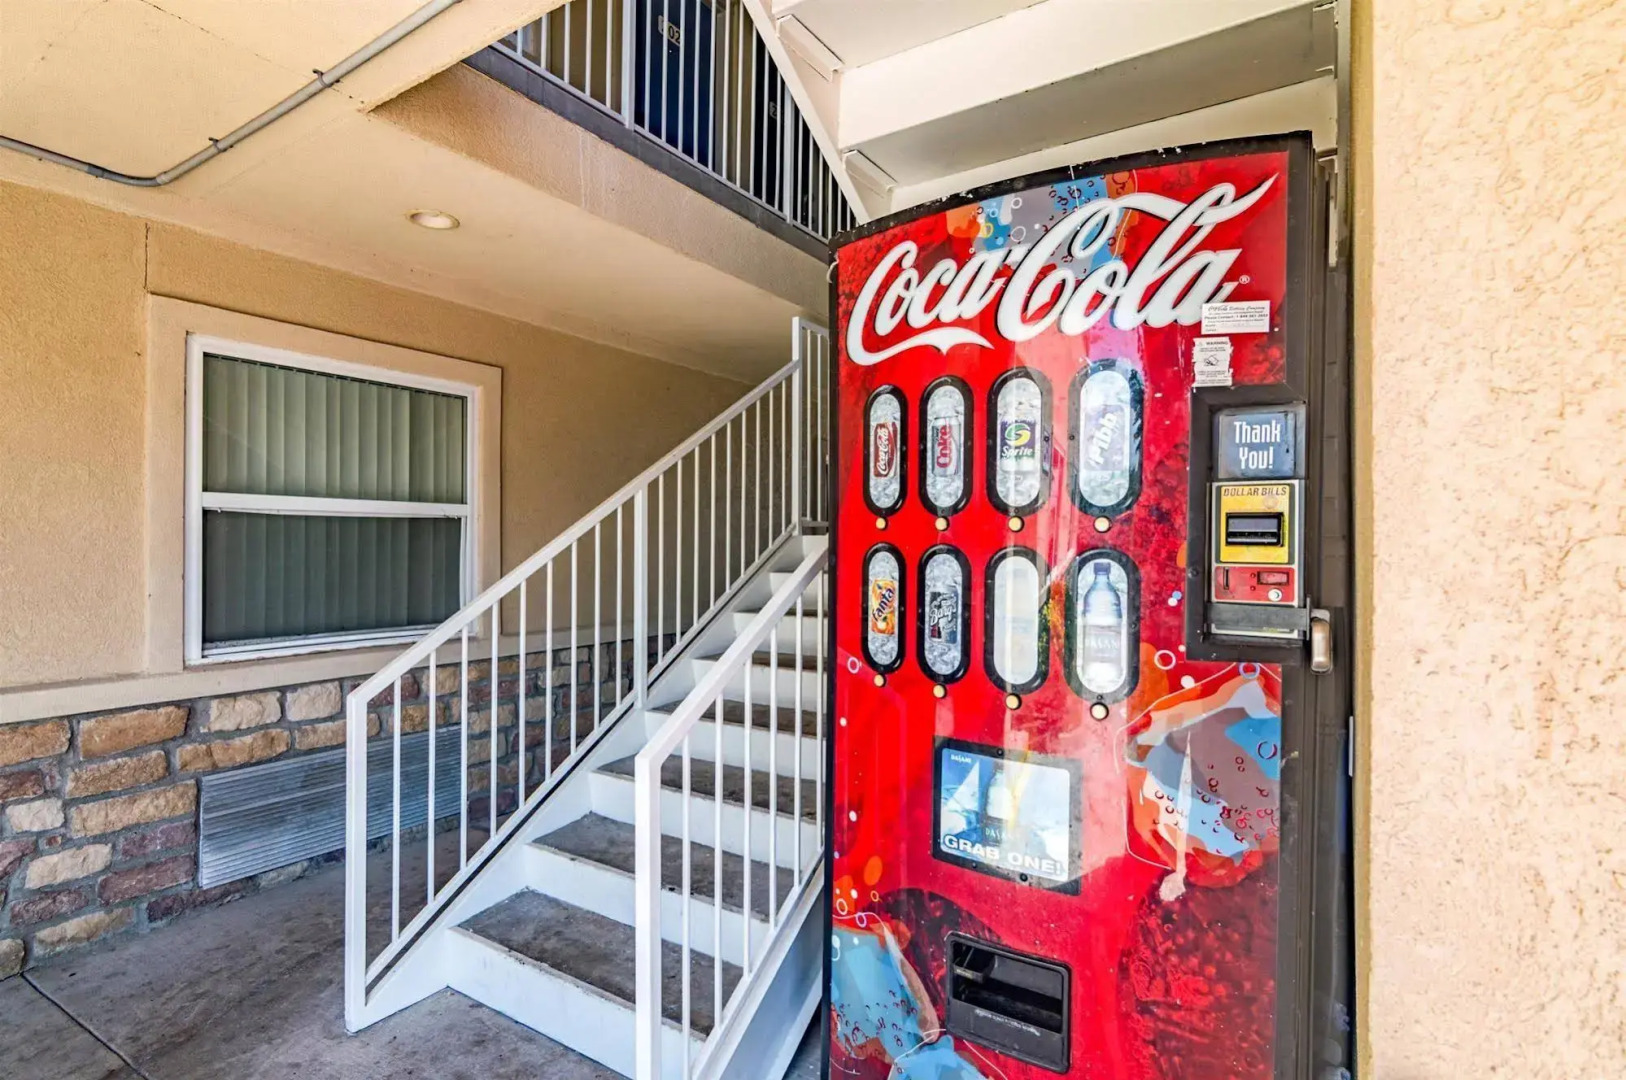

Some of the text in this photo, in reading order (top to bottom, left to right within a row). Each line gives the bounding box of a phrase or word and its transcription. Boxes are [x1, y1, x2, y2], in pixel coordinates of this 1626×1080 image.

[660, 18, 681, 45] 02
[846, 172, 1279, 366] Coca-Cola
[1233, 419, 1281, 444] Thank
[936, 424, 953, 469] Coke
[1001, 445, 1035, 460] Sprite
[1238, 445, 1275, 470] You!
[1223, 486, 1288, 497] DOLLAR BILLS
[944, 834, 1062, 876] GRAB ONE!
